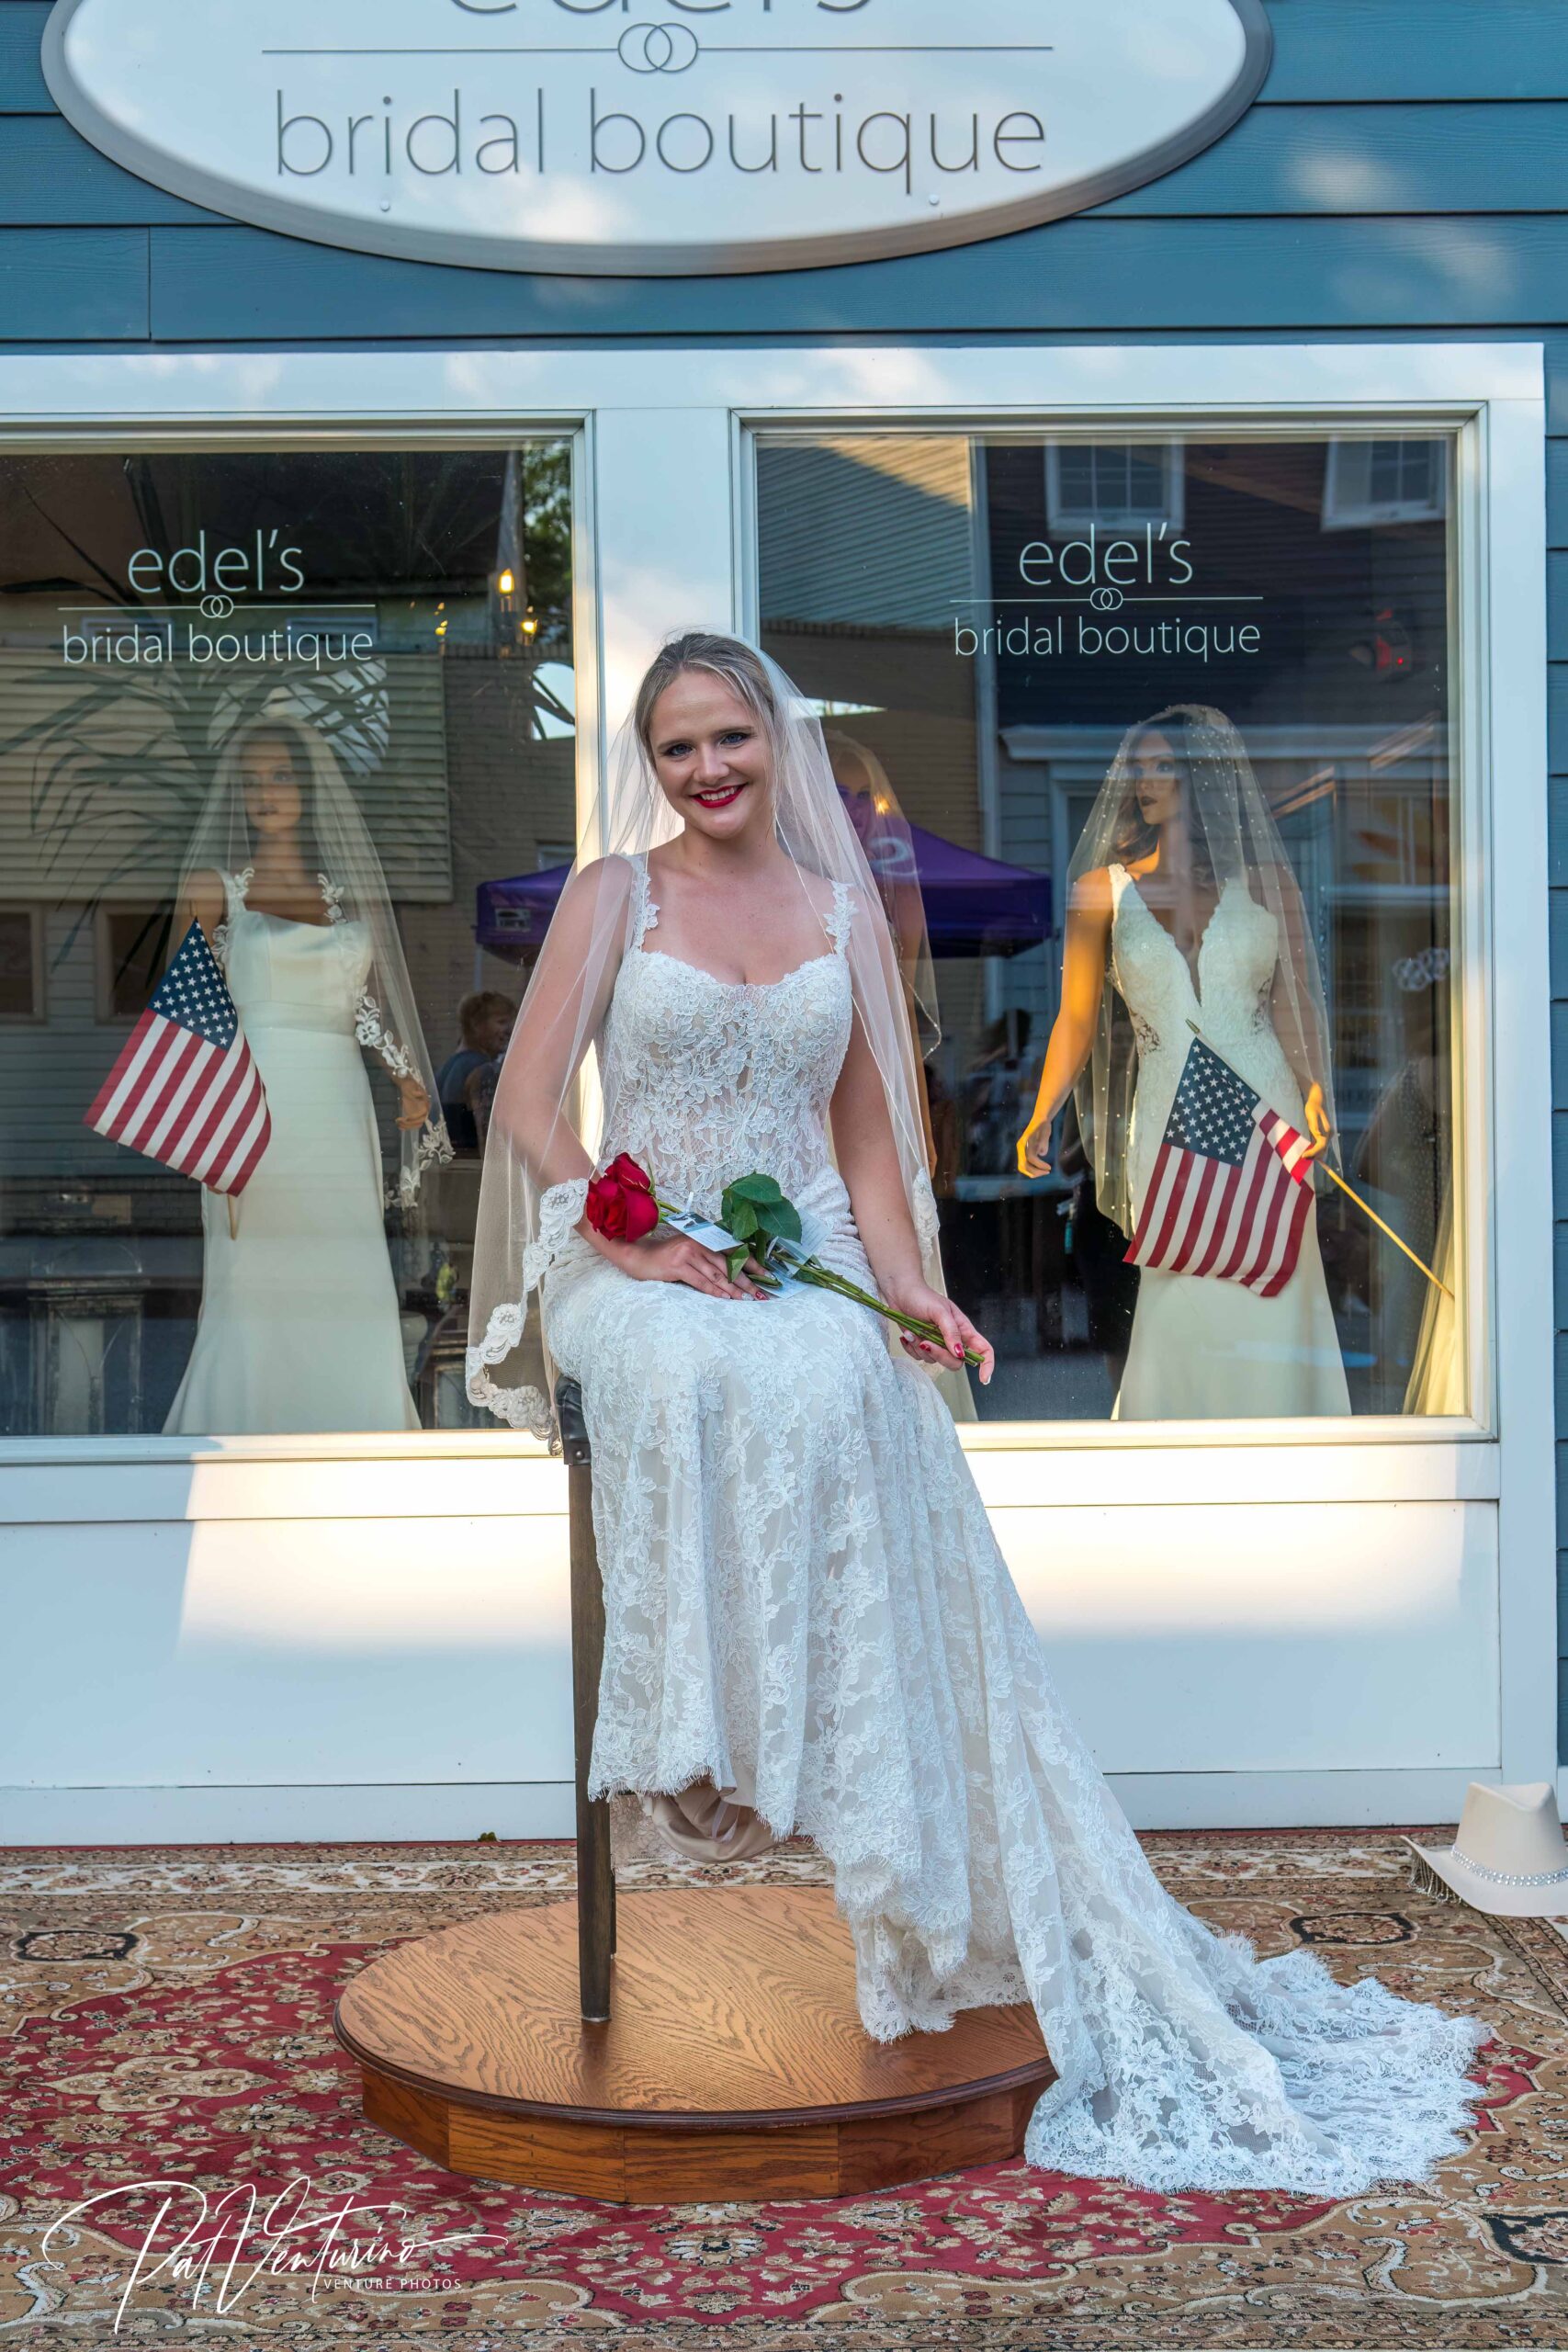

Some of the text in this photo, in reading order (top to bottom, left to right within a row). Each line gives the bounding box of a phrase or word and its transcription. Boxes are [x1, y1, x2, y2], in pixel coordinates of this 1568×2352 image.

[277, 88, 1044, 195] bridal boutique
[129, 529, 304, 594] edel's
[1020, 522, 1193, 586] edel's
[63, 624, 374, 671] bridal boutique
[955, 616, 1261, 662] bridal boutique
